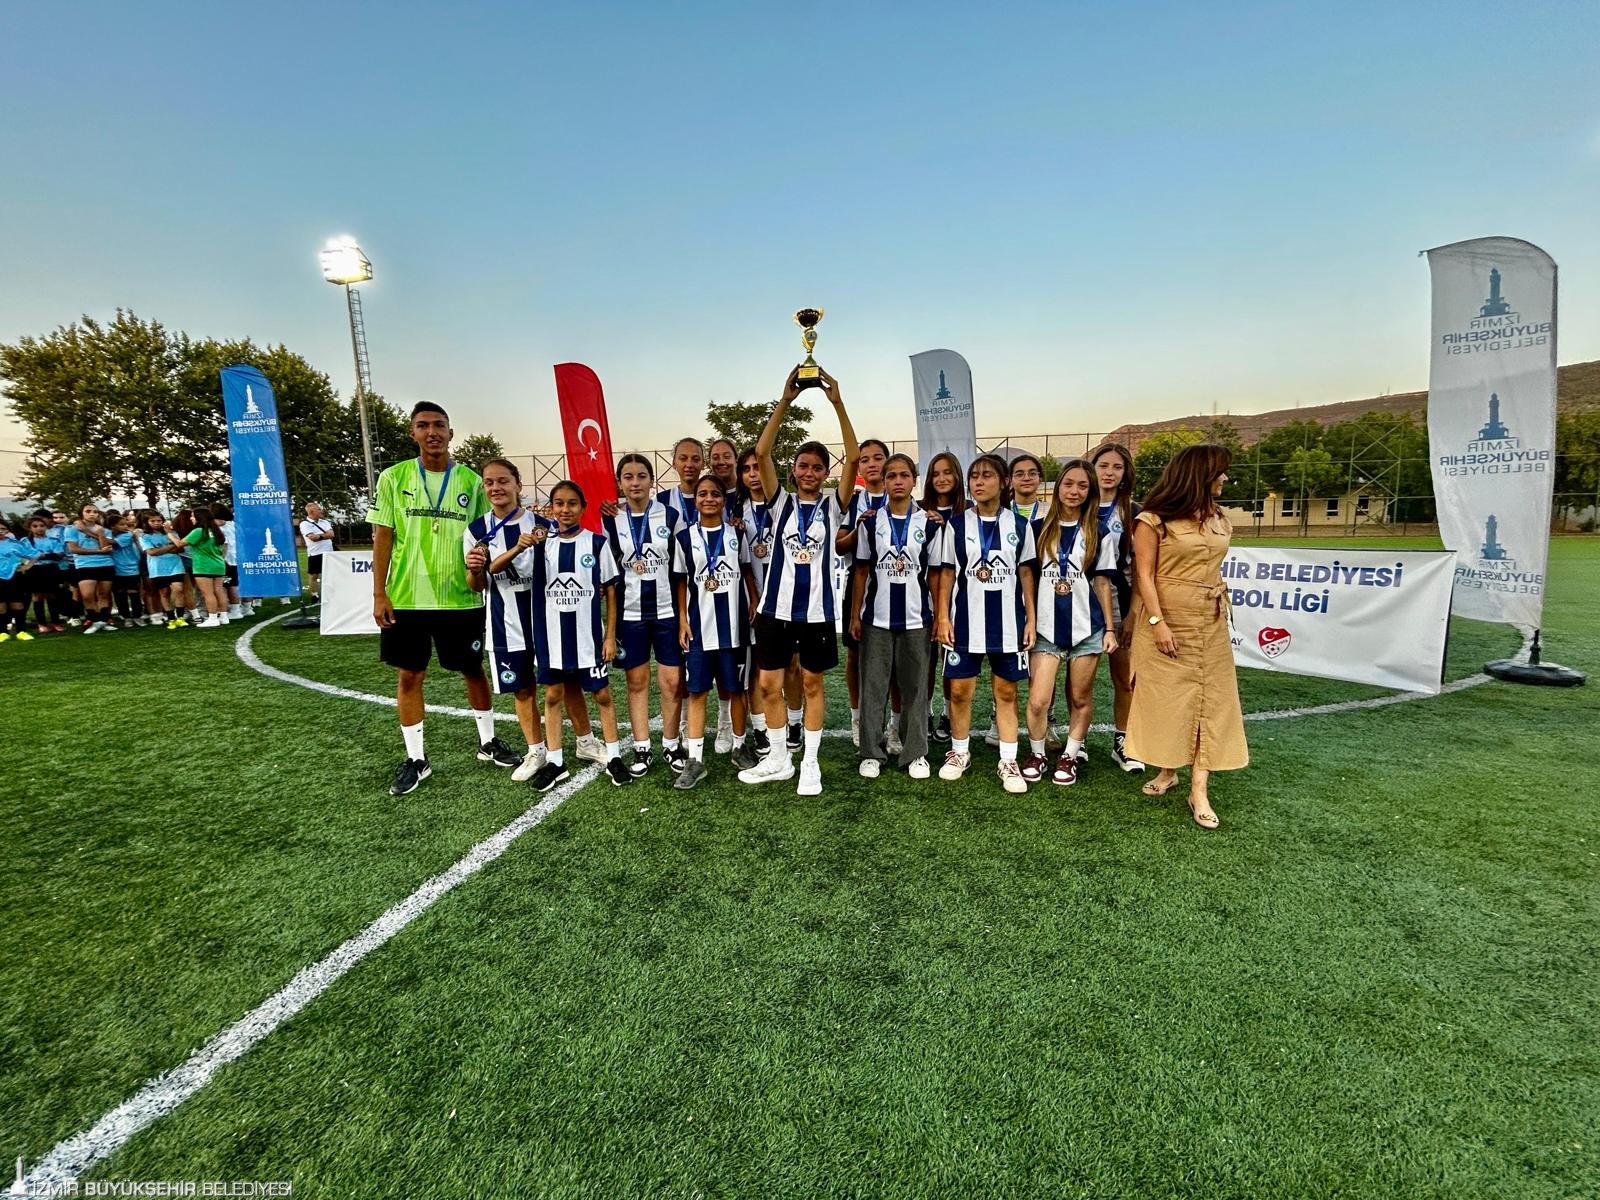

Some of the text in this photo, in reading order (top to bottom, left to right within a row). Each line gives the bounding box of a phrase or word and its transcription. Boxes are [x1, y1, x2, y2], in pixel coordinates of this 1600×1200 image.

[1255, 560, 1404, 588] BELEDİYESİ
[556, 598, 580, 606] GRUP
[1280, 586, 1330, 613] LİGİ
[737, 663, 746, 682] 7
